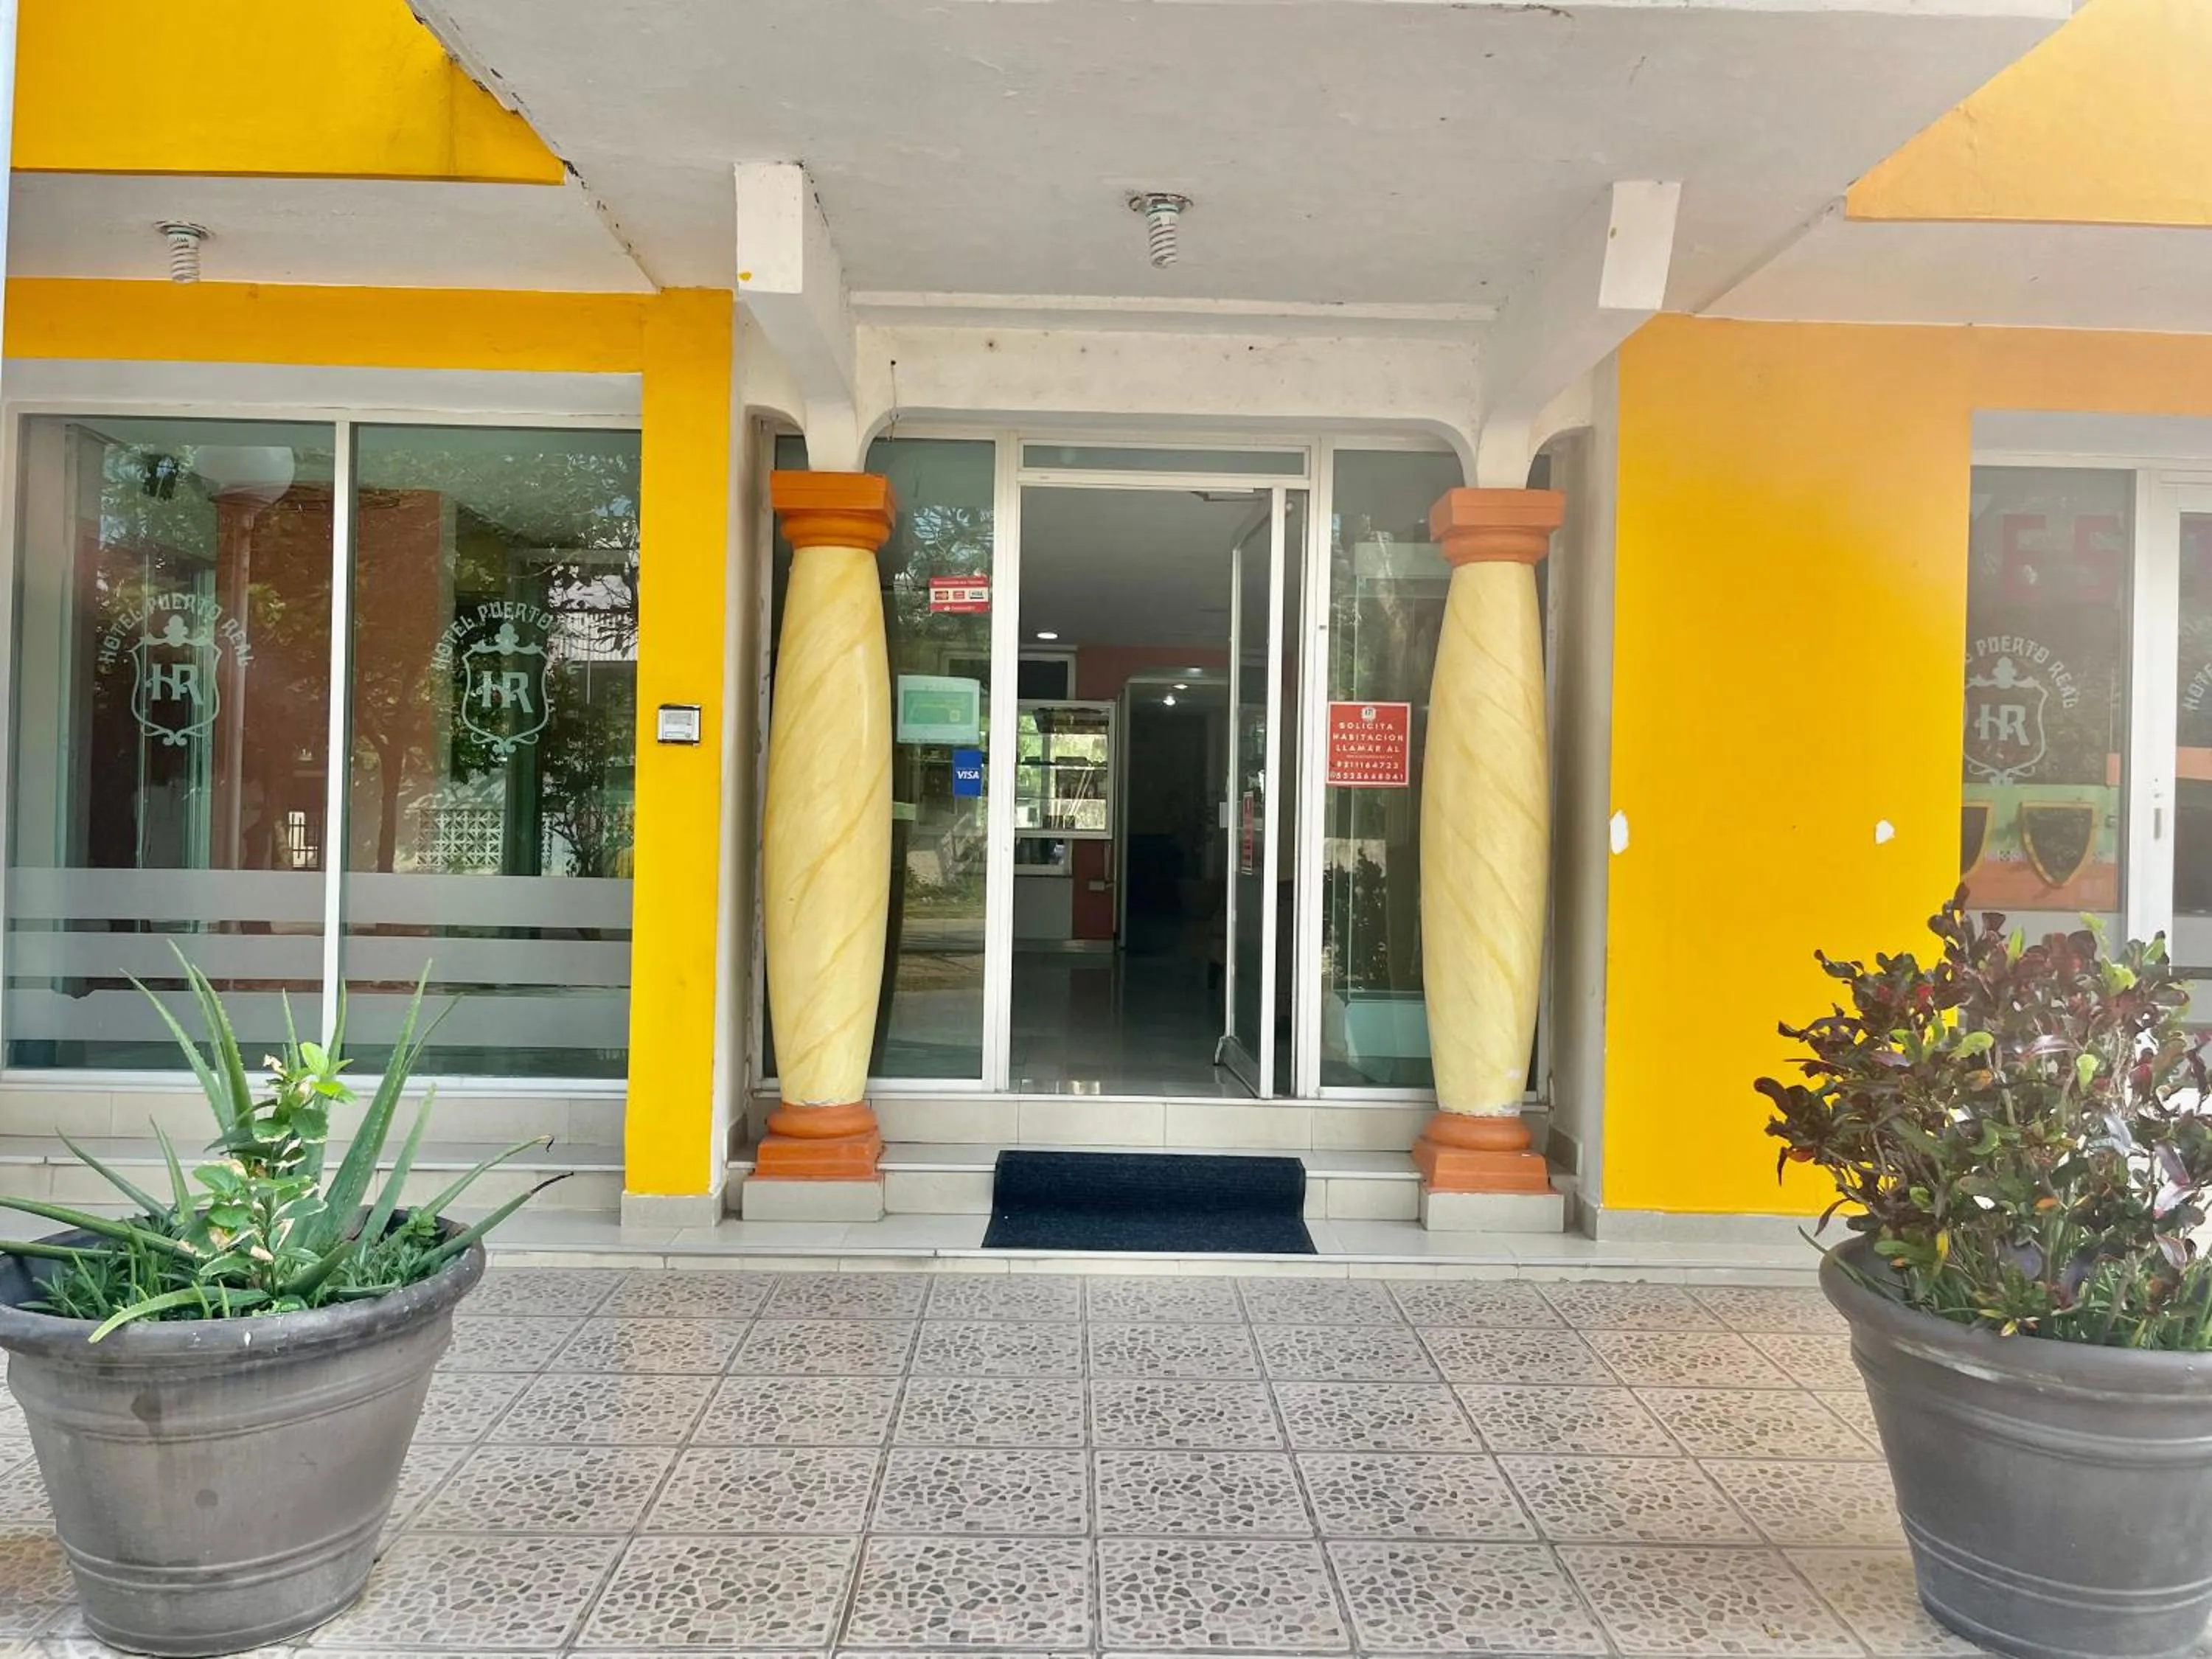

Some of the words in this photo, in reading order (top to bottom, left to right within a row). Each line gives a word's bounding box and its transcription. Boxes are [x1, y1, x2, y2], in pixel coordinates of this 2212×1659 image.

[97, 608, 145, 664] HOTEL
[147, 593, 223, 622] PUERTO
[221, 618, 254, 667] REAL
[431, 615, 478, 671] HOTEL
[478, 601, 554, 630] PUERTO
[1976, 635, 2051, 664] PUERTO
[2048, 661, 2079, 709] REAL
[1338, 722, 1393, 730] SOLICITA
[1332, 733, 1403, 741] HABITACION
[1335, 744, 1381, 752] LLAMAR
[1387, 745, 1400, 753] AL
[956, 771, 981, 779] VISA
